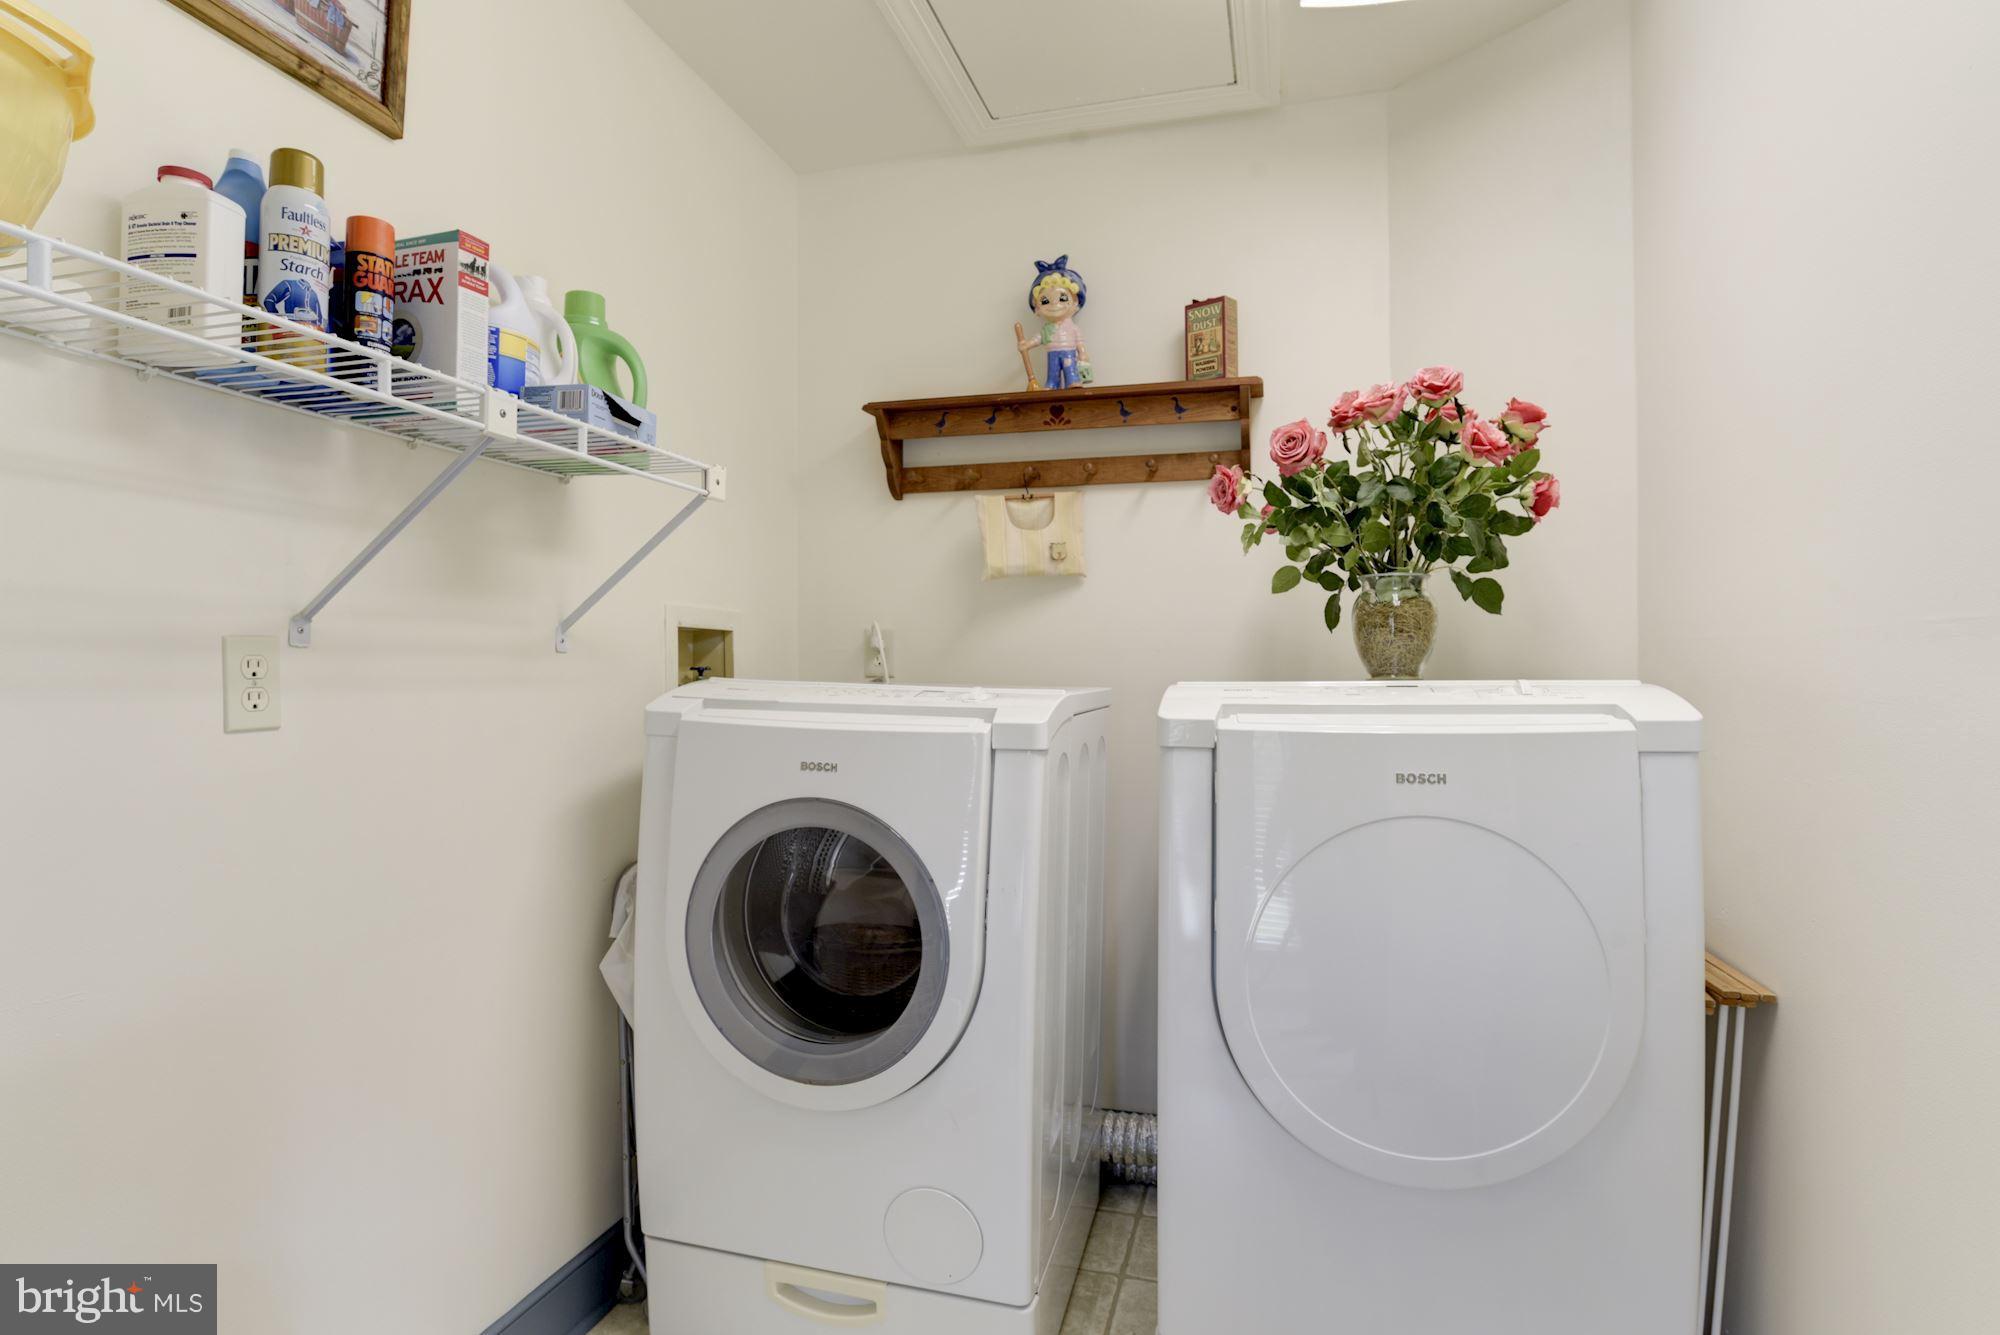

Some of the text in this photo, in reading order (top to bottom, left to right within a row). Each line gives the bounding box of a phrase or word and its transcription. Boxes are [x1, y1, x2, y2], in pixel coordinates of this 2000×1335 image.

[281, 206, 327, 232] Faultless
[395, 248, 445, 269] LE TEAM
[280, 258, 324, 281] Starch
[393, 276, 445, 305] RAX
[1188, 304, 1222, 320] SNOW
[1193, 318, 1217, 331] DUST
[800, 761, 838, 773] BOSCH
[1395, 772, 1447, 785] BOSCH
